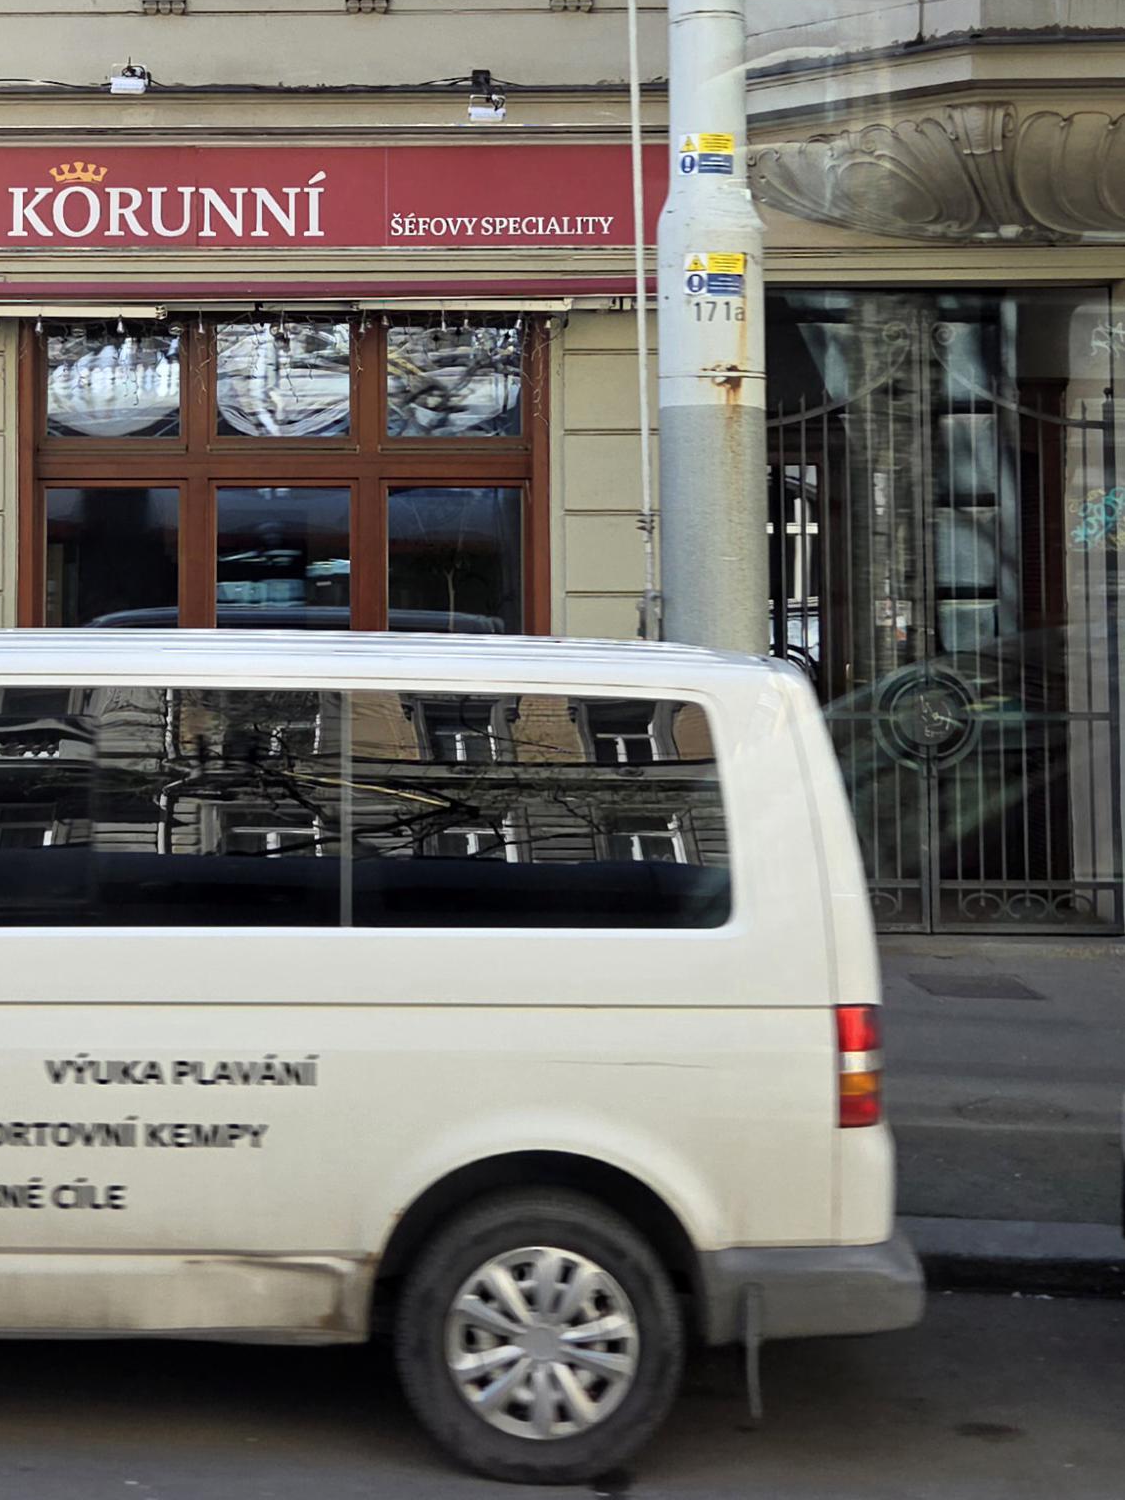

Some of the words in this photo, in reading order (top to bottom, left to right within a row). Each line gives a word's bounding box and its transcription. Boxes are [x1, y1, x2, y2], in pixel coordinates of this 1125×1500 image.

[7, 170, 327, 238] KORUNNÍ
[390, 212, 477, 236] ŠÉFOVY
[480, 216, 614, 236] SPECIALITY
[45, 1052, 165, 1085] VÝUKA
[171, 1053, 320, 1086] PLAVÁNÍ
[143, 1123, 270, 1148] KEMPY
[51, 1177, 129, 1210] CÍLE
